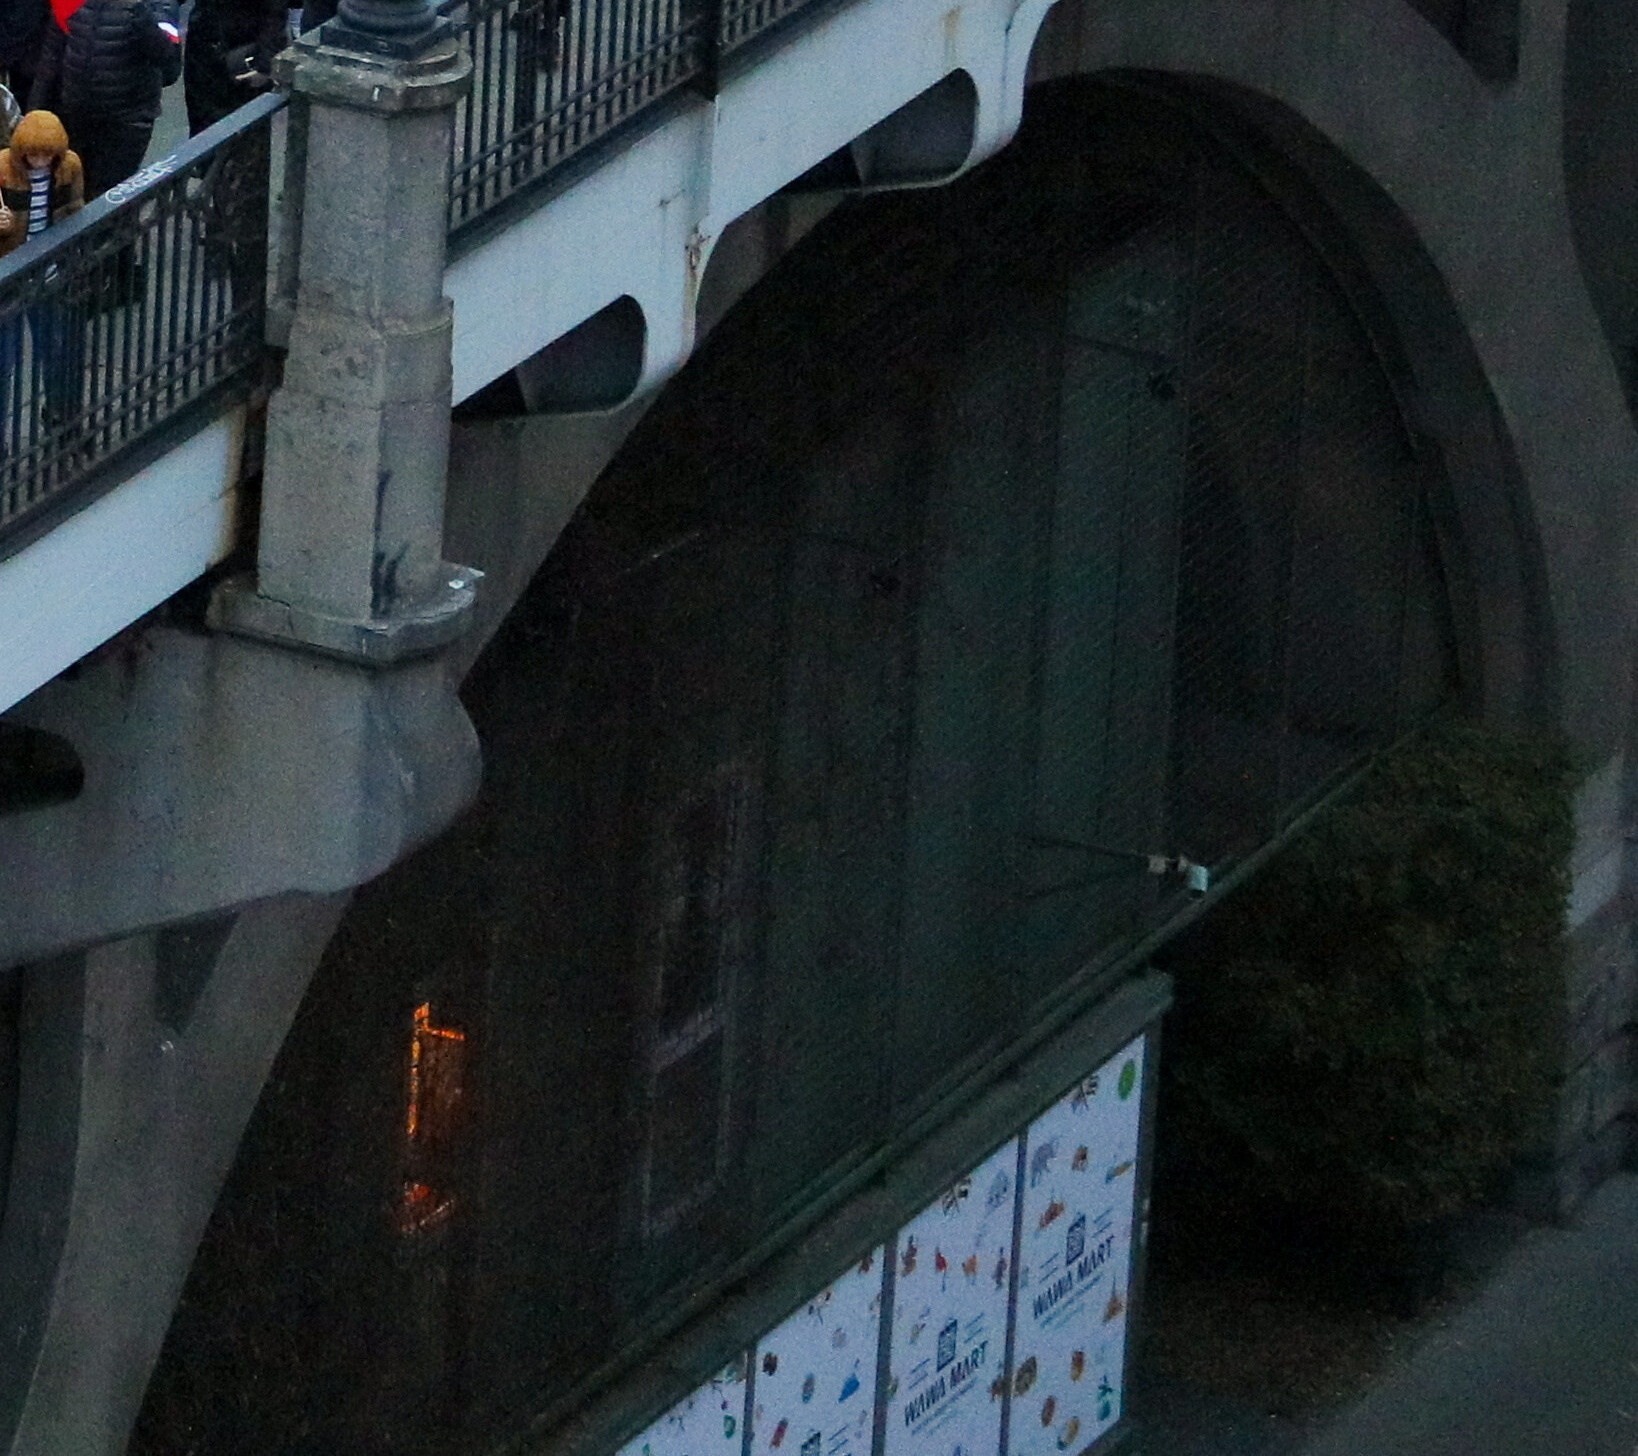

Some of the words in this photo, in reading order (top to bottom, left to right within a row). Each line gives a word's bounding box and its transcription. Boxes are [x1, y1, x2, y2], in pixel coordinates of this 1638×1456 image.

[1033, 1275, 1076, 1320] WAWA
[1078, 1235, 1116, 1280] MART
[903, 1375, 947, 1427] WAWA
[948, 1338, 989, 1382] MART
